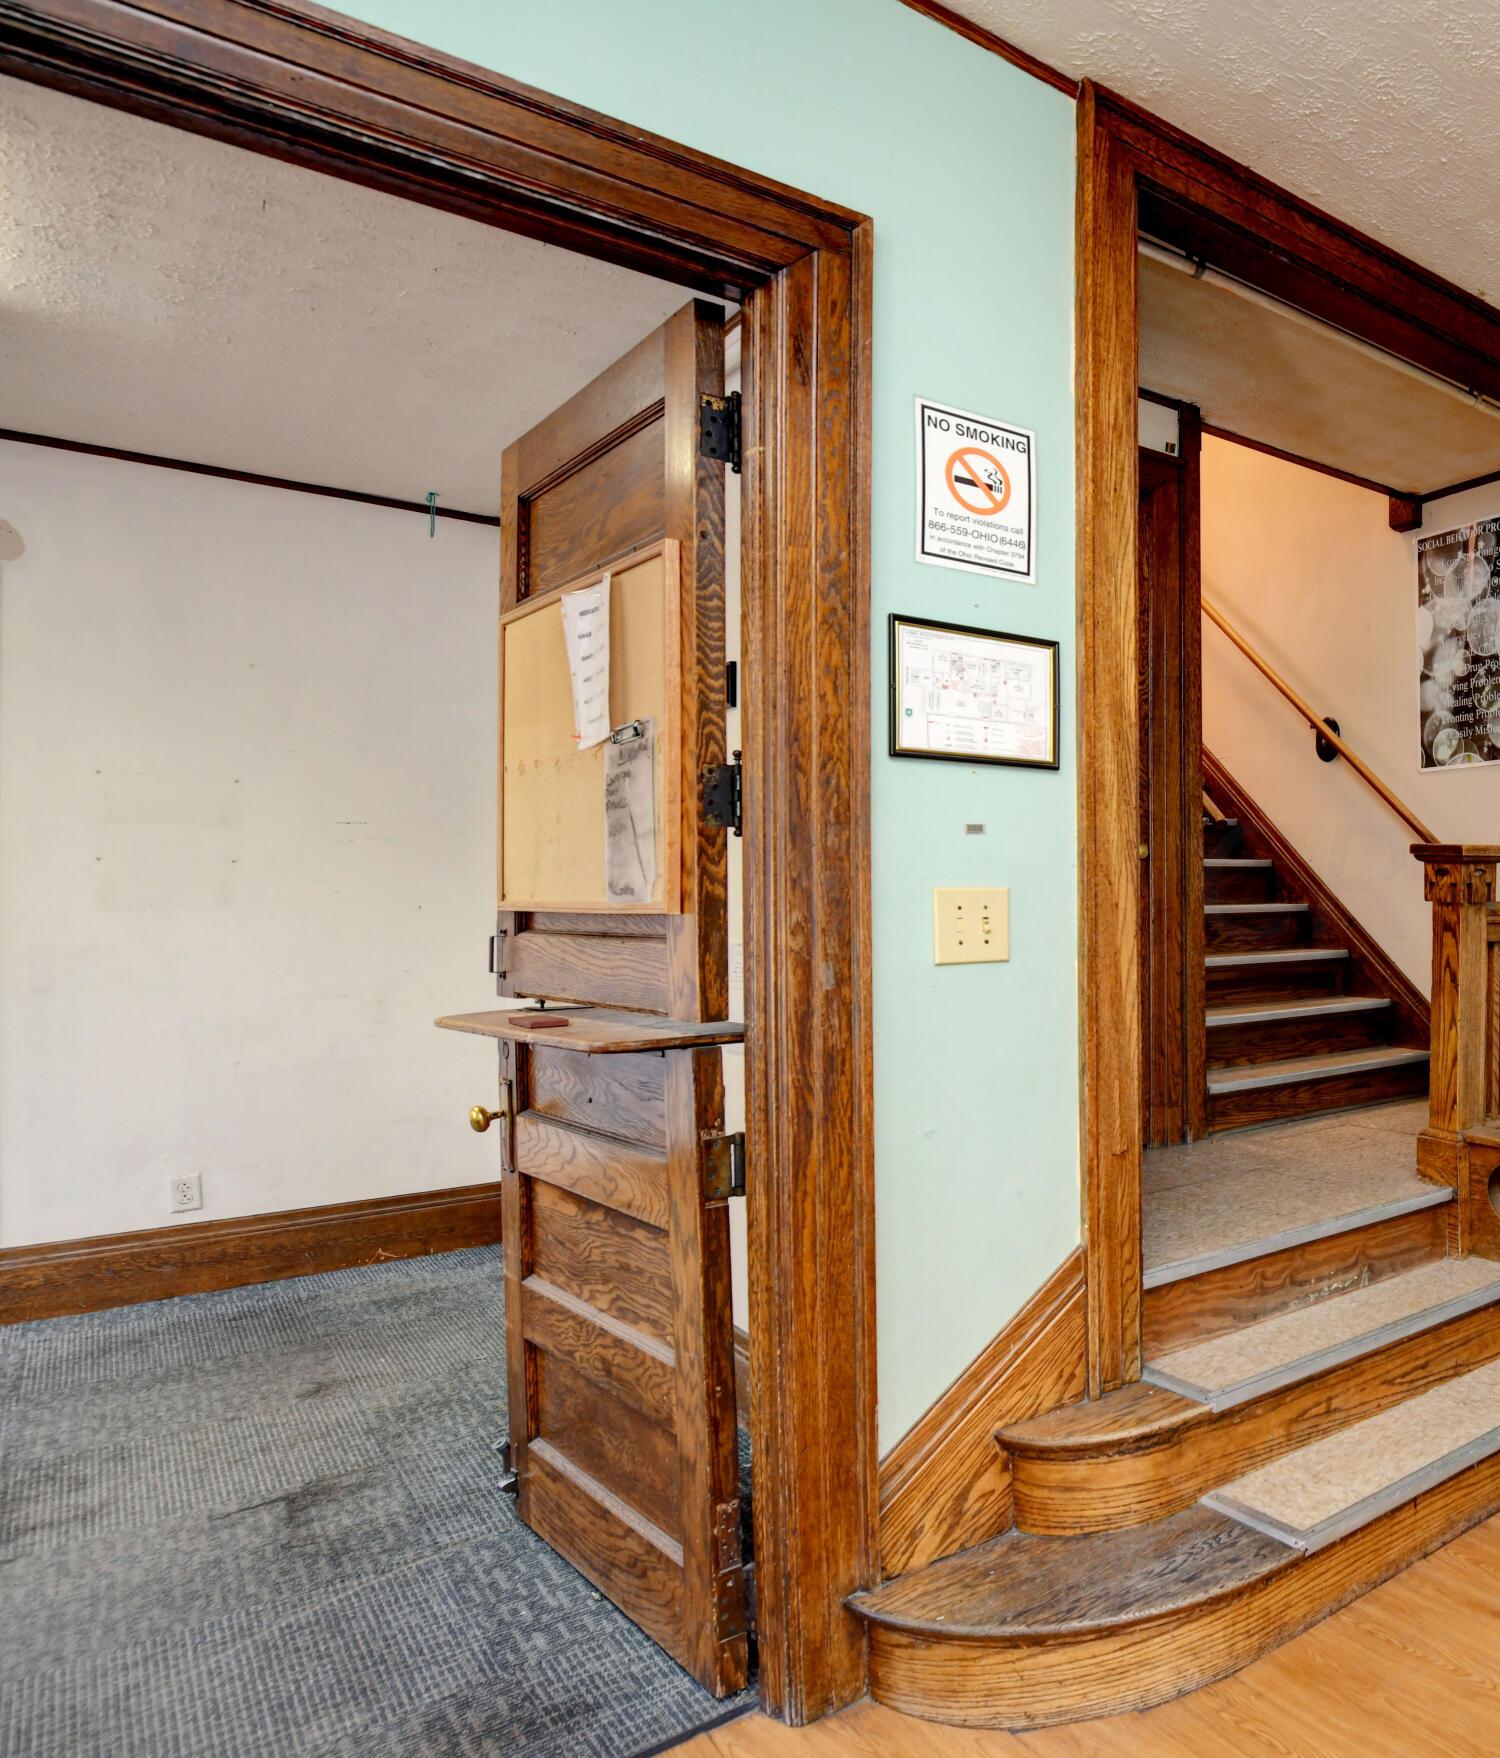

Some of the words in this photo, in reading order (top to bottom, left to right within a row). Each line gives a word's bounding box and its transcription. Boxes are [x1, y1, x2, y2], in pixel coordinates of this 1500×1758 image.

[927, 414, 951, 432] NO
[955, 423, 1027, 454] SMOKING
[934, 508, 945, 517] To
[946, 512, 971, 523] report
[972, 518, 1009, 532] violations
[1010, 526, 1024, 535] call
[928, 520, 999, 544] 866-559-OHIO
[999, 536, 1026, 551] (6446)
[937, 536, 972, 548] accordance
[973, 542, 985, 551] with
[986, 546, 1009, 557] Chapter
[1417, 537, 1446, 553] SOCIAL
[1446, 526, 1484, 546] BEHAVOR
[958, 550, 973, 559] Ohio
[973, 553, 998, 564] Revised
